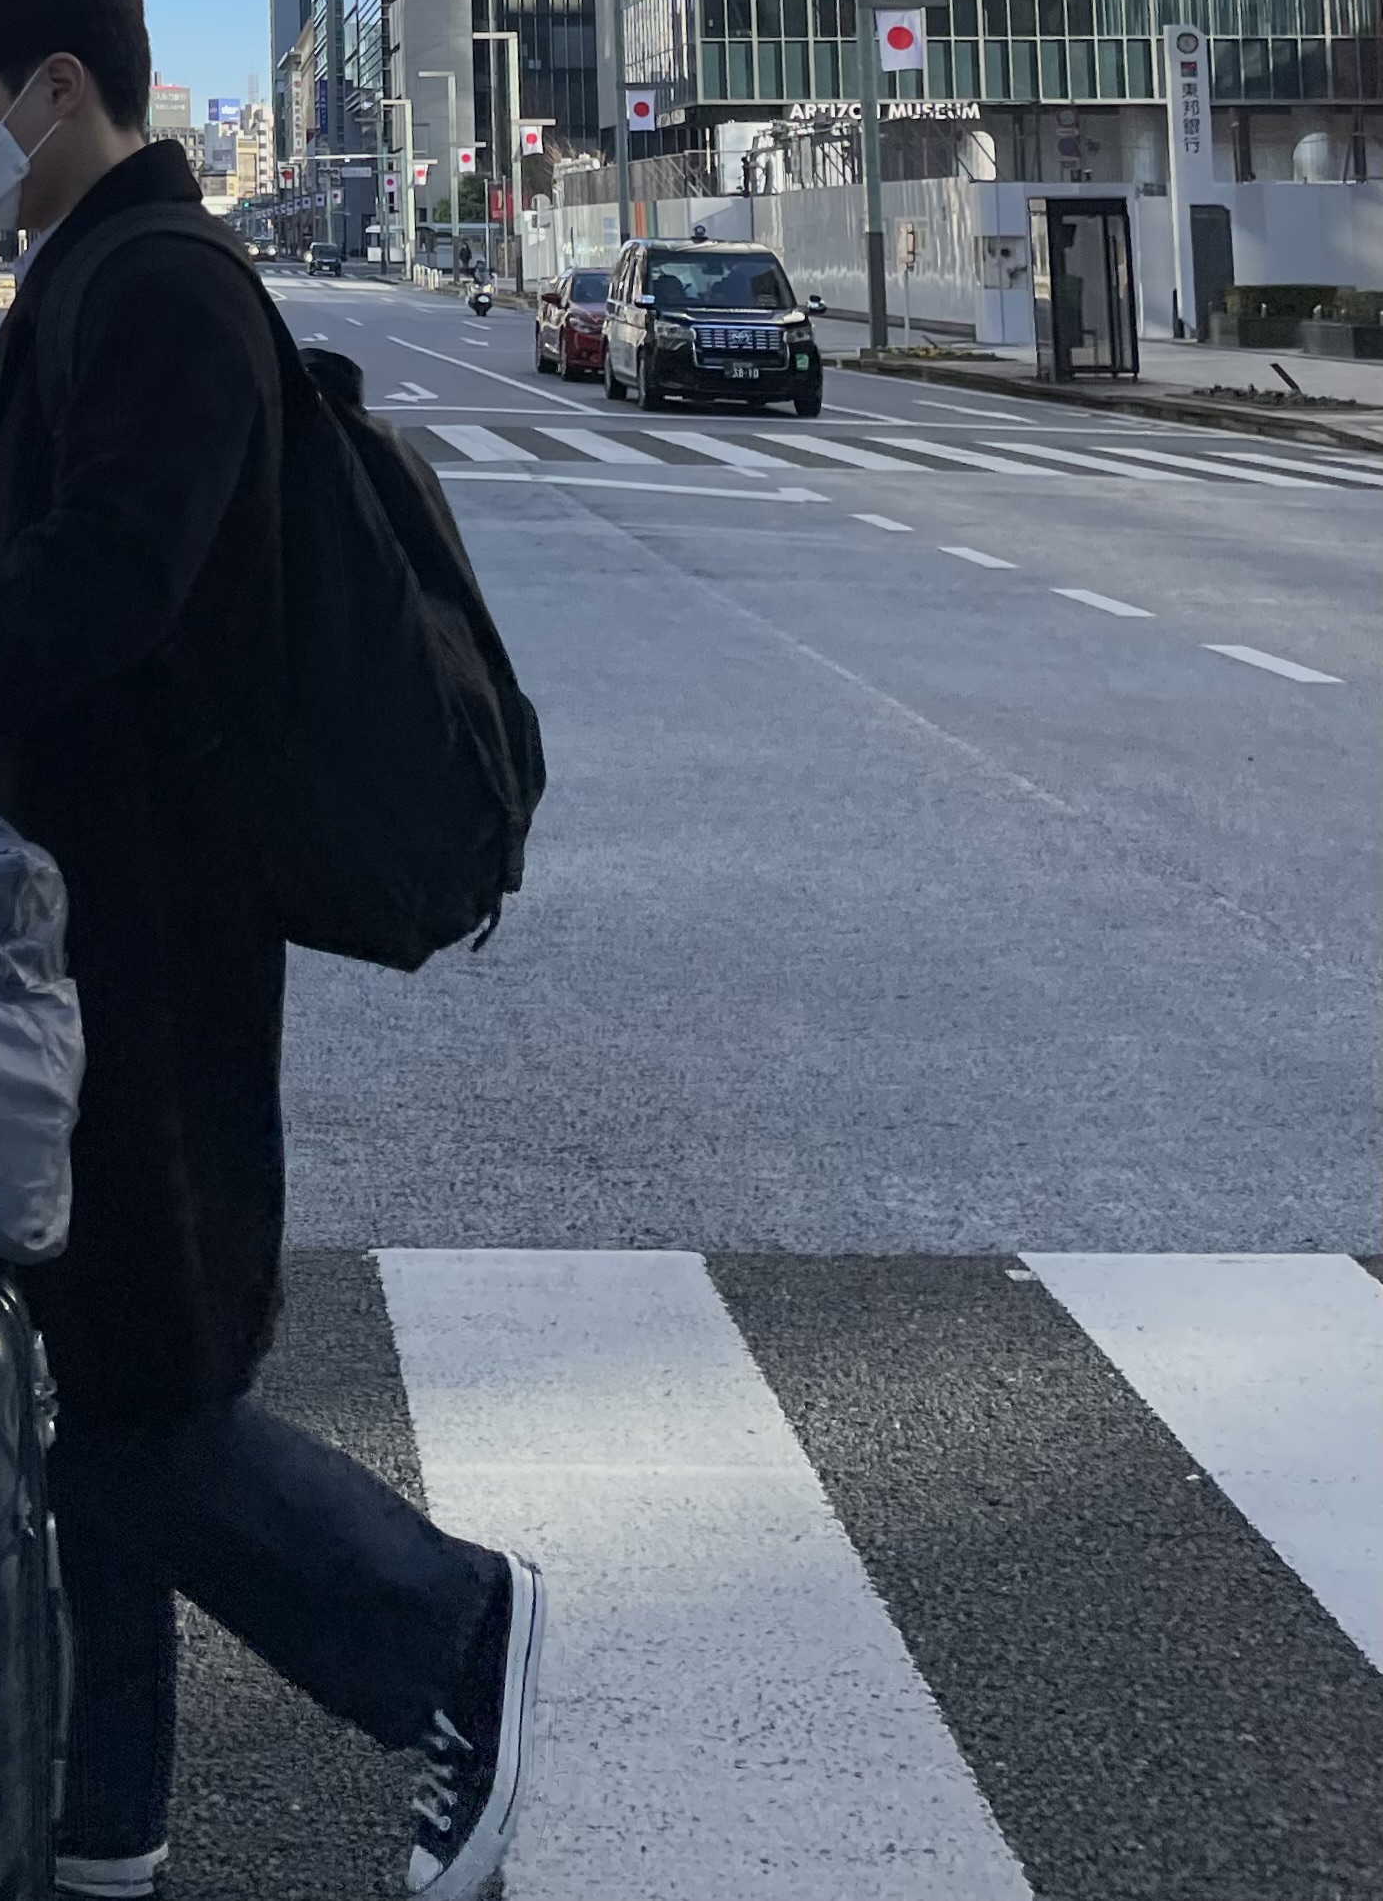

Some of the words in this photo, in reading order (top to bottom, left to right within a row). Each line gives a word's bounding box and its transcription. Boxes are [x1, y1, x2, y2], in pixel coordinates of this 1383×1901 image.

[789, 103, 881, 120] ARTIZO
[888, 103, 981, 120] MUSEUM
[1182, 83, 1200, 154] 東邦銀行
